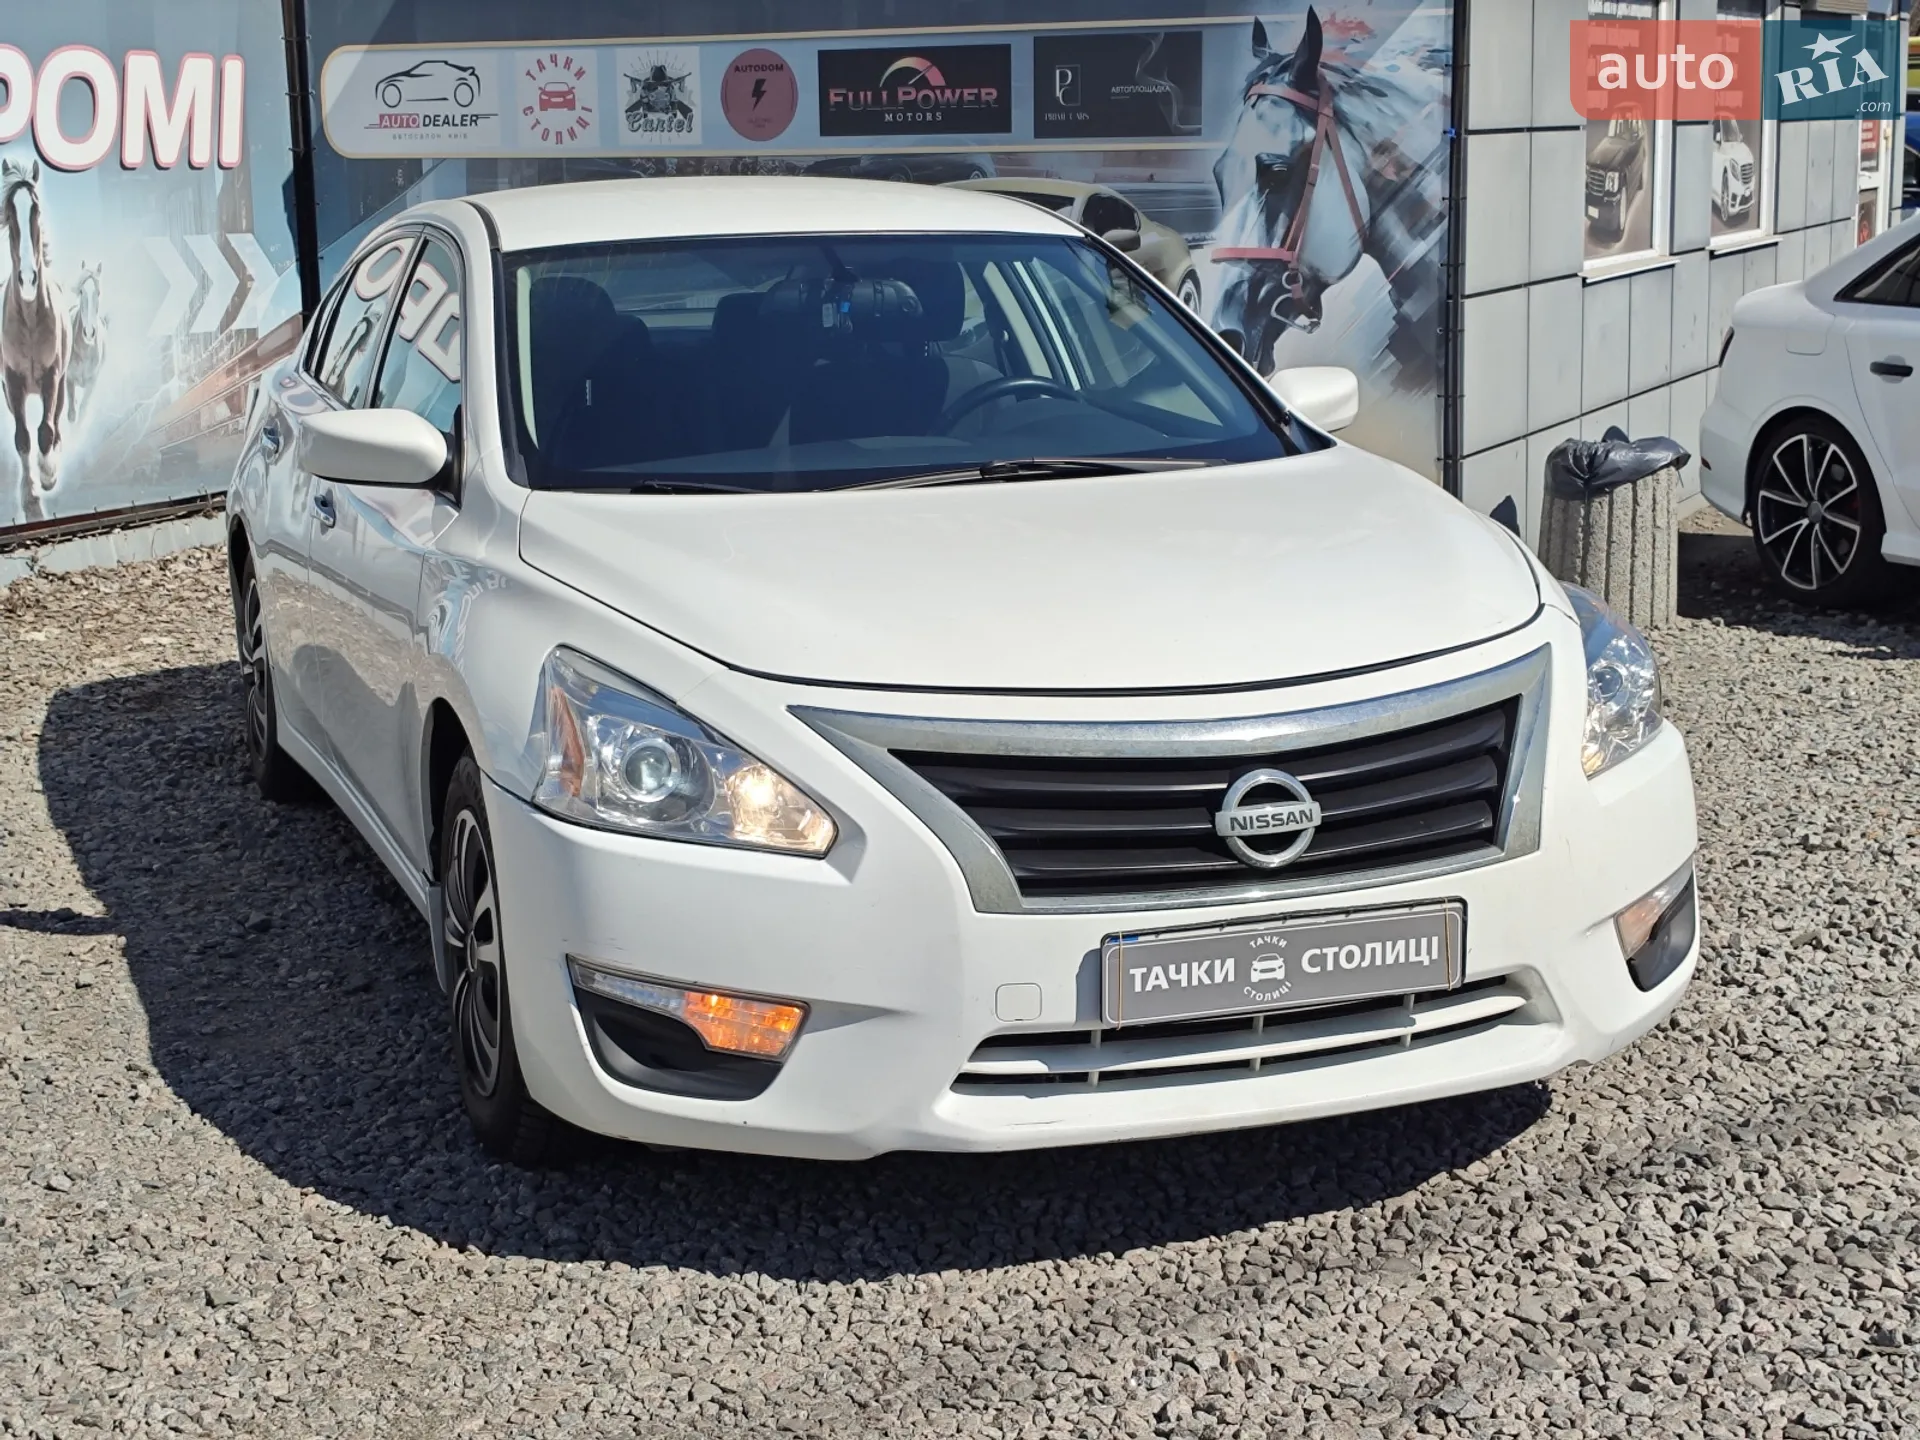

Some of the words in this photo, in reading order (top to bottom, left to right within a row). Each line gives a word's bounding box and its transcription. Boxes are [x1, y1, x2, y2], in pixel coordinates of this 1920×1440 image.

[525, 53, 586, 81] ТАЧКИ
[733, 63, 784, 73] AUTODOM
[1111, 85, 1171, 93] АВТОПЛОЩАДКА
[381, 115, 420, 128] AUTO
[422, 114, 479, 127] DEALER
[522, 104, 593, 145] СТОЛИЦІ
[884, 112, 943, 122] MOTORS
[1229, 808, 1314, 832] NISSAN
[1249, 935, 1288, 949] ТАЧКИ
[1128, 957, 1236, 993] ТАЧКИ
[1300, 935, 1440, 974] СТОЛИЦІ
[1242, 981, 1293, 1002] СТОЛИЦІ
